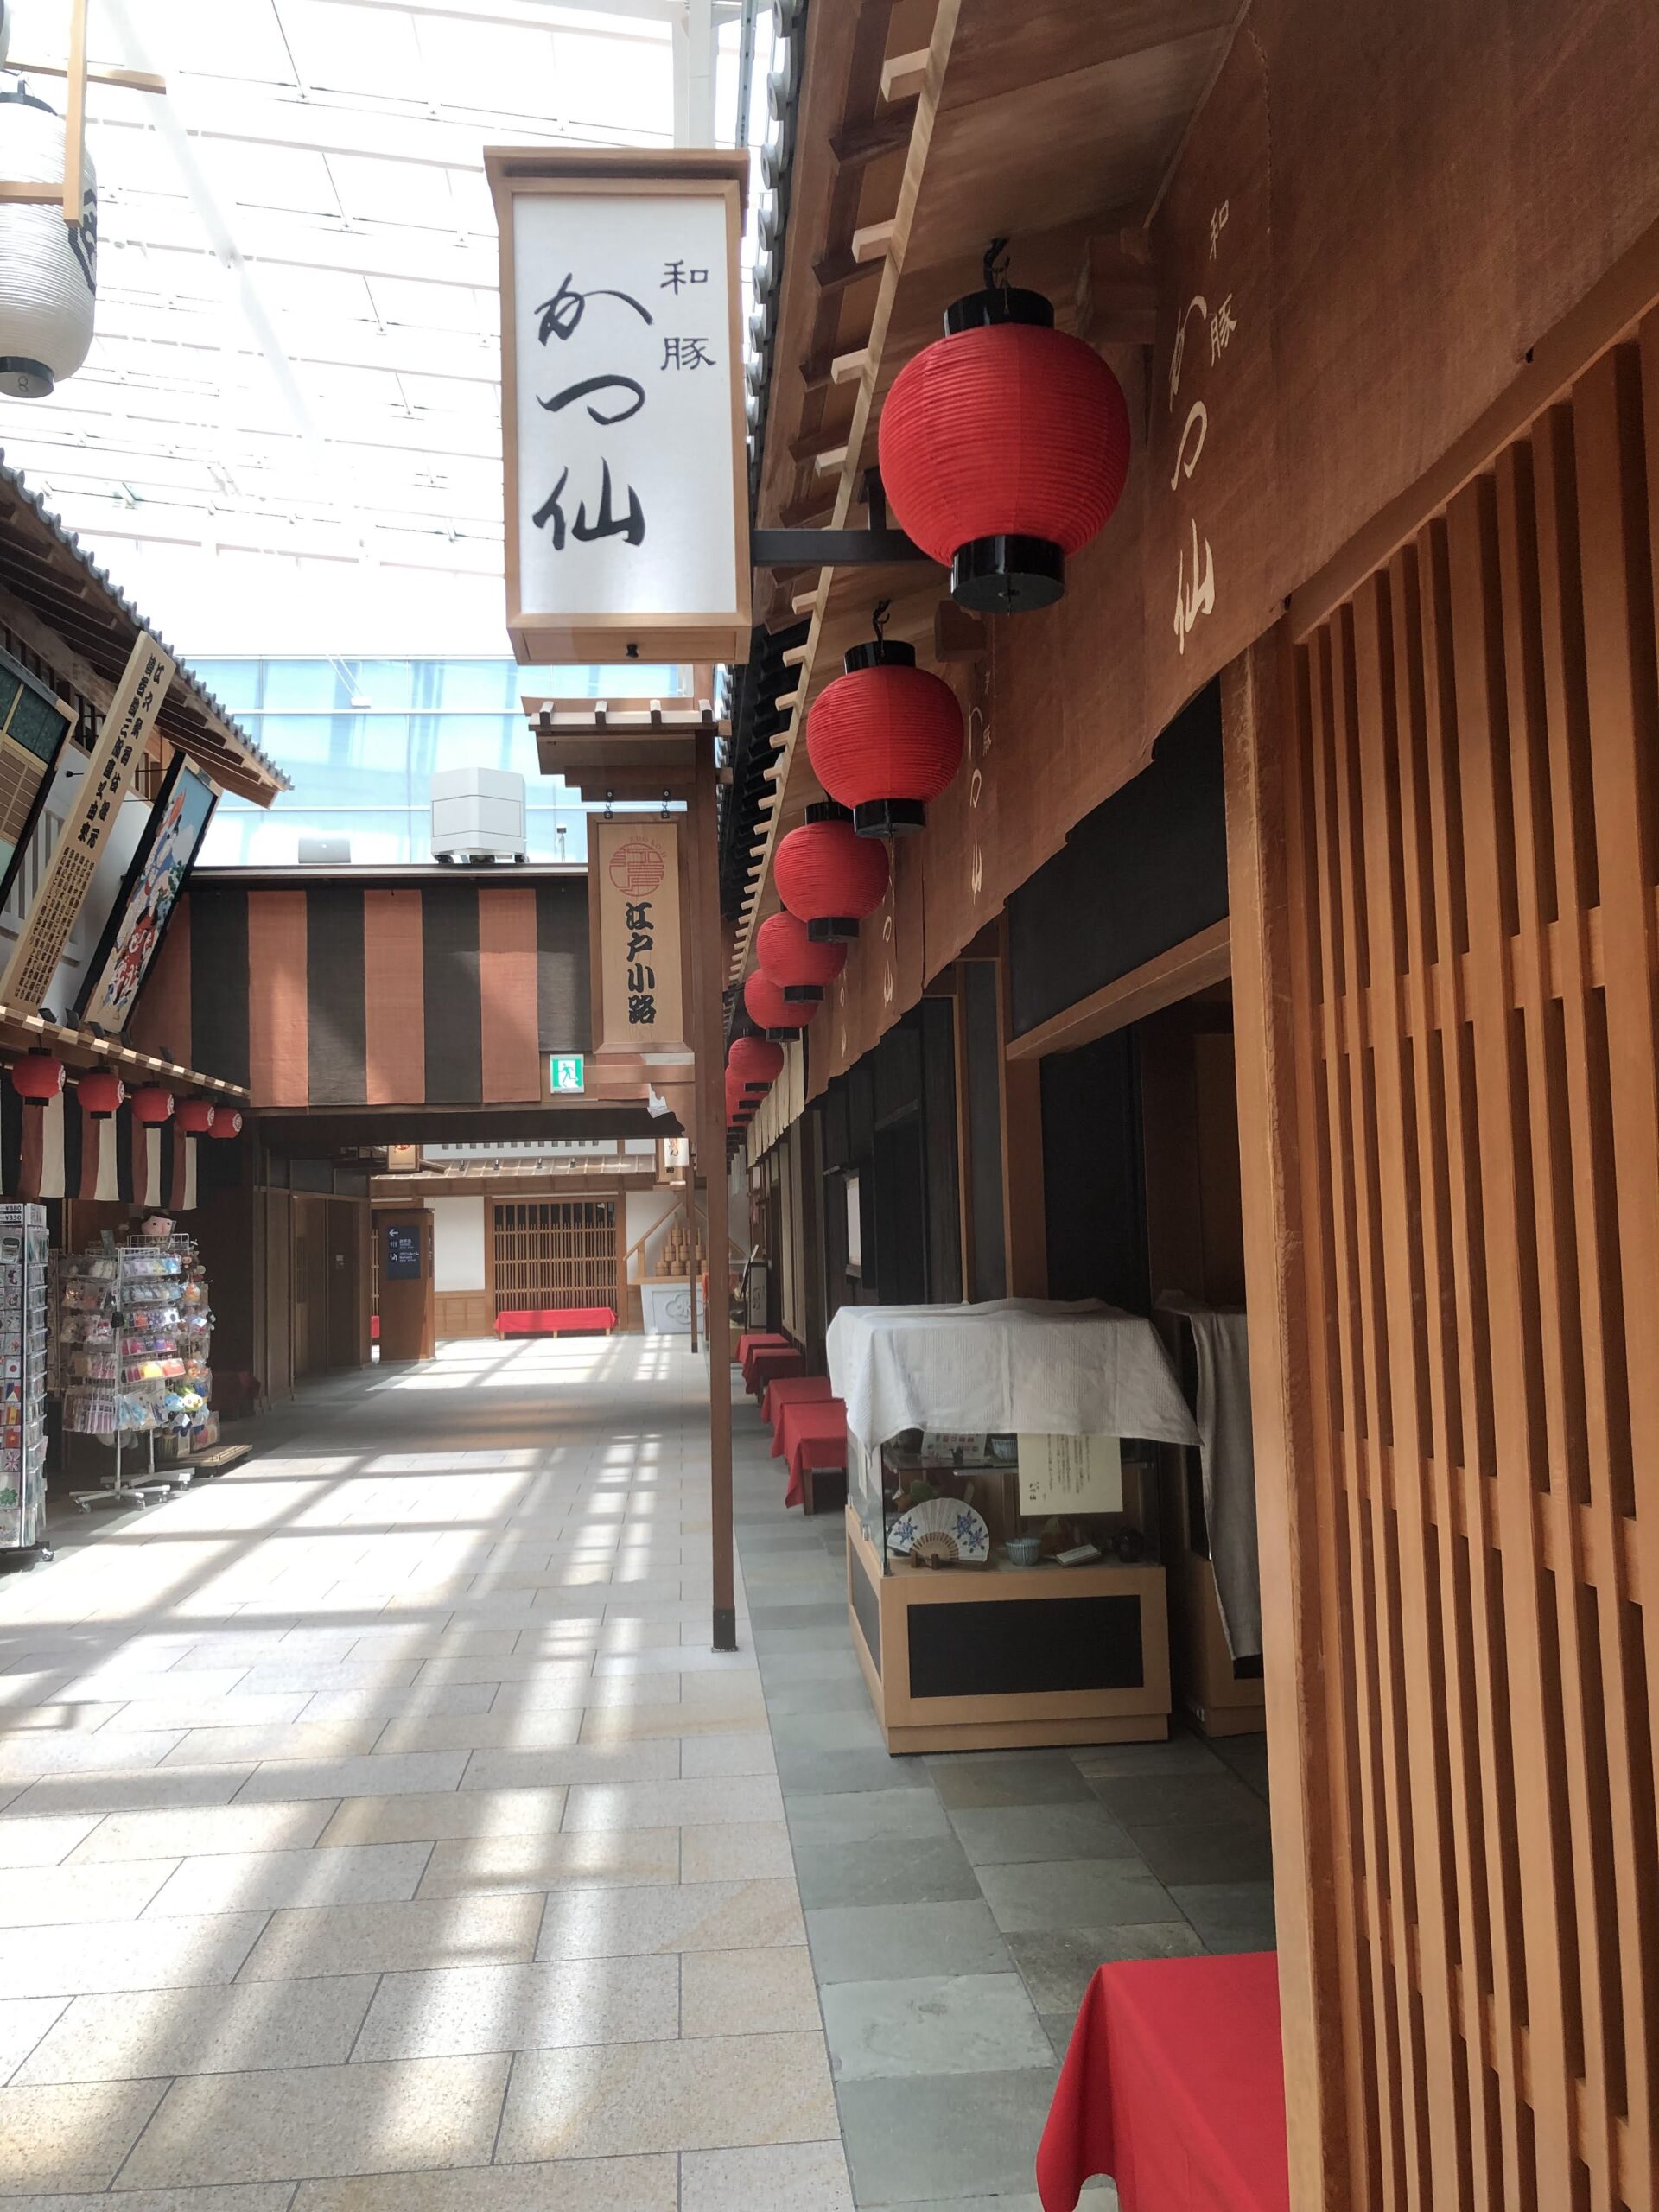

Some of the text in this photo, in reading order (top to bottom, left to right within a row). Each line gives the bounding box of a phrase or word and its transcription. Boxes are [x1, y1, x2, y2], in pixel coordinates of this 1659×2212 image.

[660, 259, 716, 370] 和豚
[1210, 199, 1237, 366] 和豚
[532, 273, 654, 550] かつ仙
[1169, 295, 1216, 656] かつ仙
[626, 902, 657, 1025] 江戸小路
